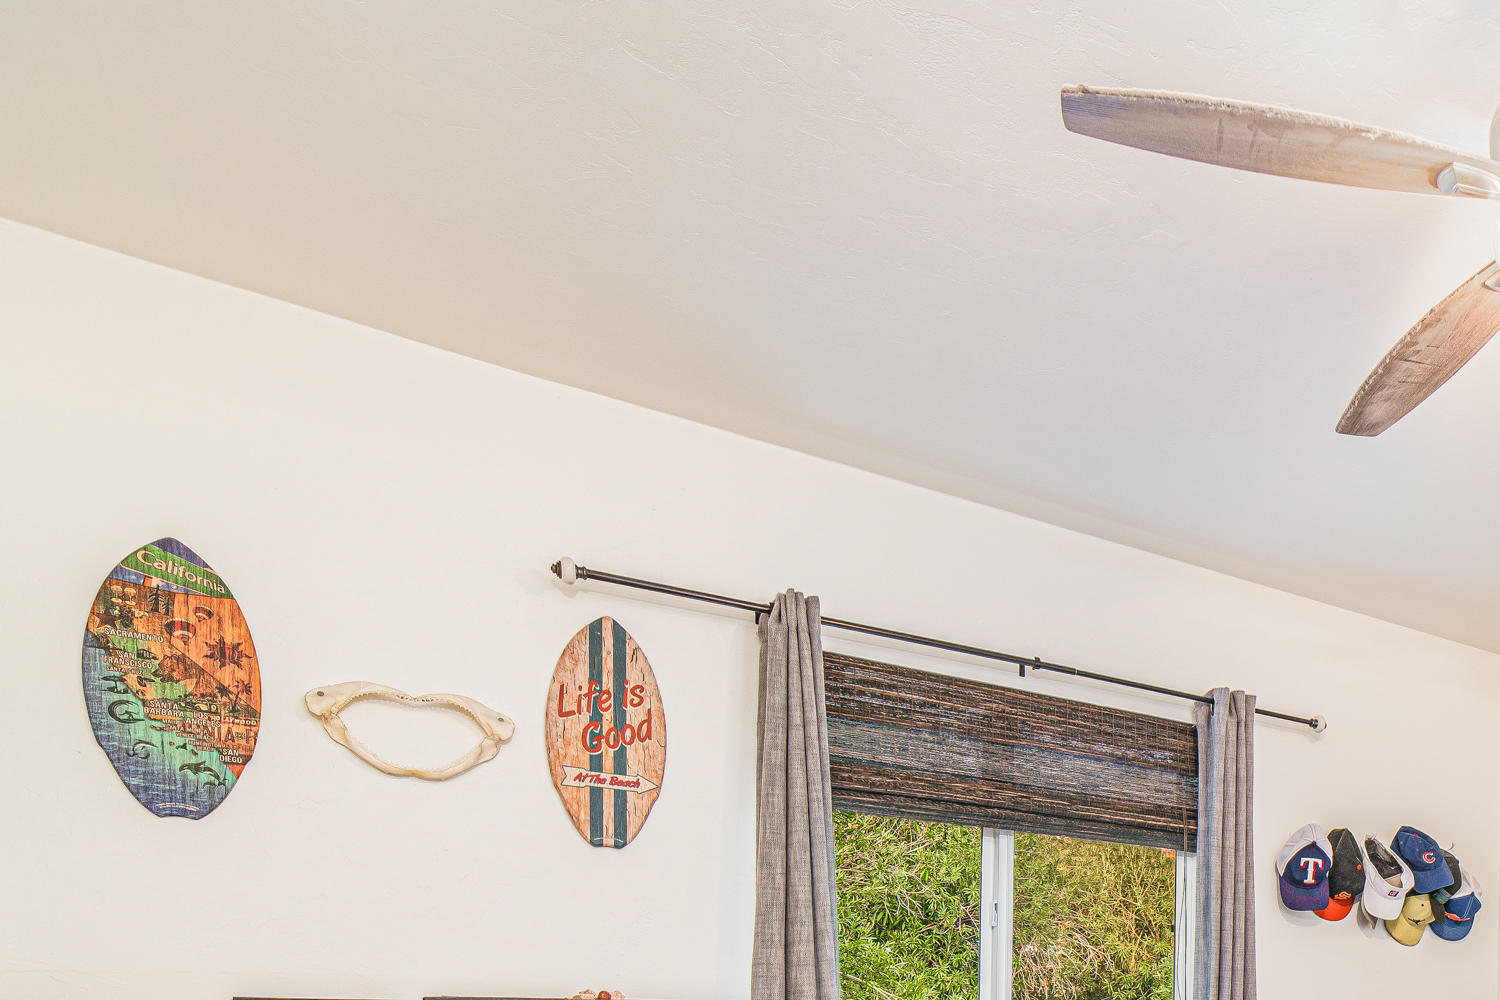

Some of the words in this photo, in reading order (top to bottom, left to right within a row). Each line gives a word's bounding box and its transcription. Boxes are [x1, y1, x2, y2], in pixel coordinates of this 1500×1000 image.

[136, 549, 226, 594] California
[104, 627, 164, 643] SACRAMENTO
[150, 700, 179, 710] SANTA
[557, 679, 613, 719] Life
[621, 679, 645, 710] is
[143, 706, 185, 718] BARBARA
[185, 717, 221, 728] ANGELES
[581, 708, 653, 755] Good
[222, 748, 239, 756] SAN
[219, 755, 243, 764] DIEGO
[608, 776, 641, 789] Beach
[1422, 851, 1436, 864] C
[1300, 857, 1325, 885] T
